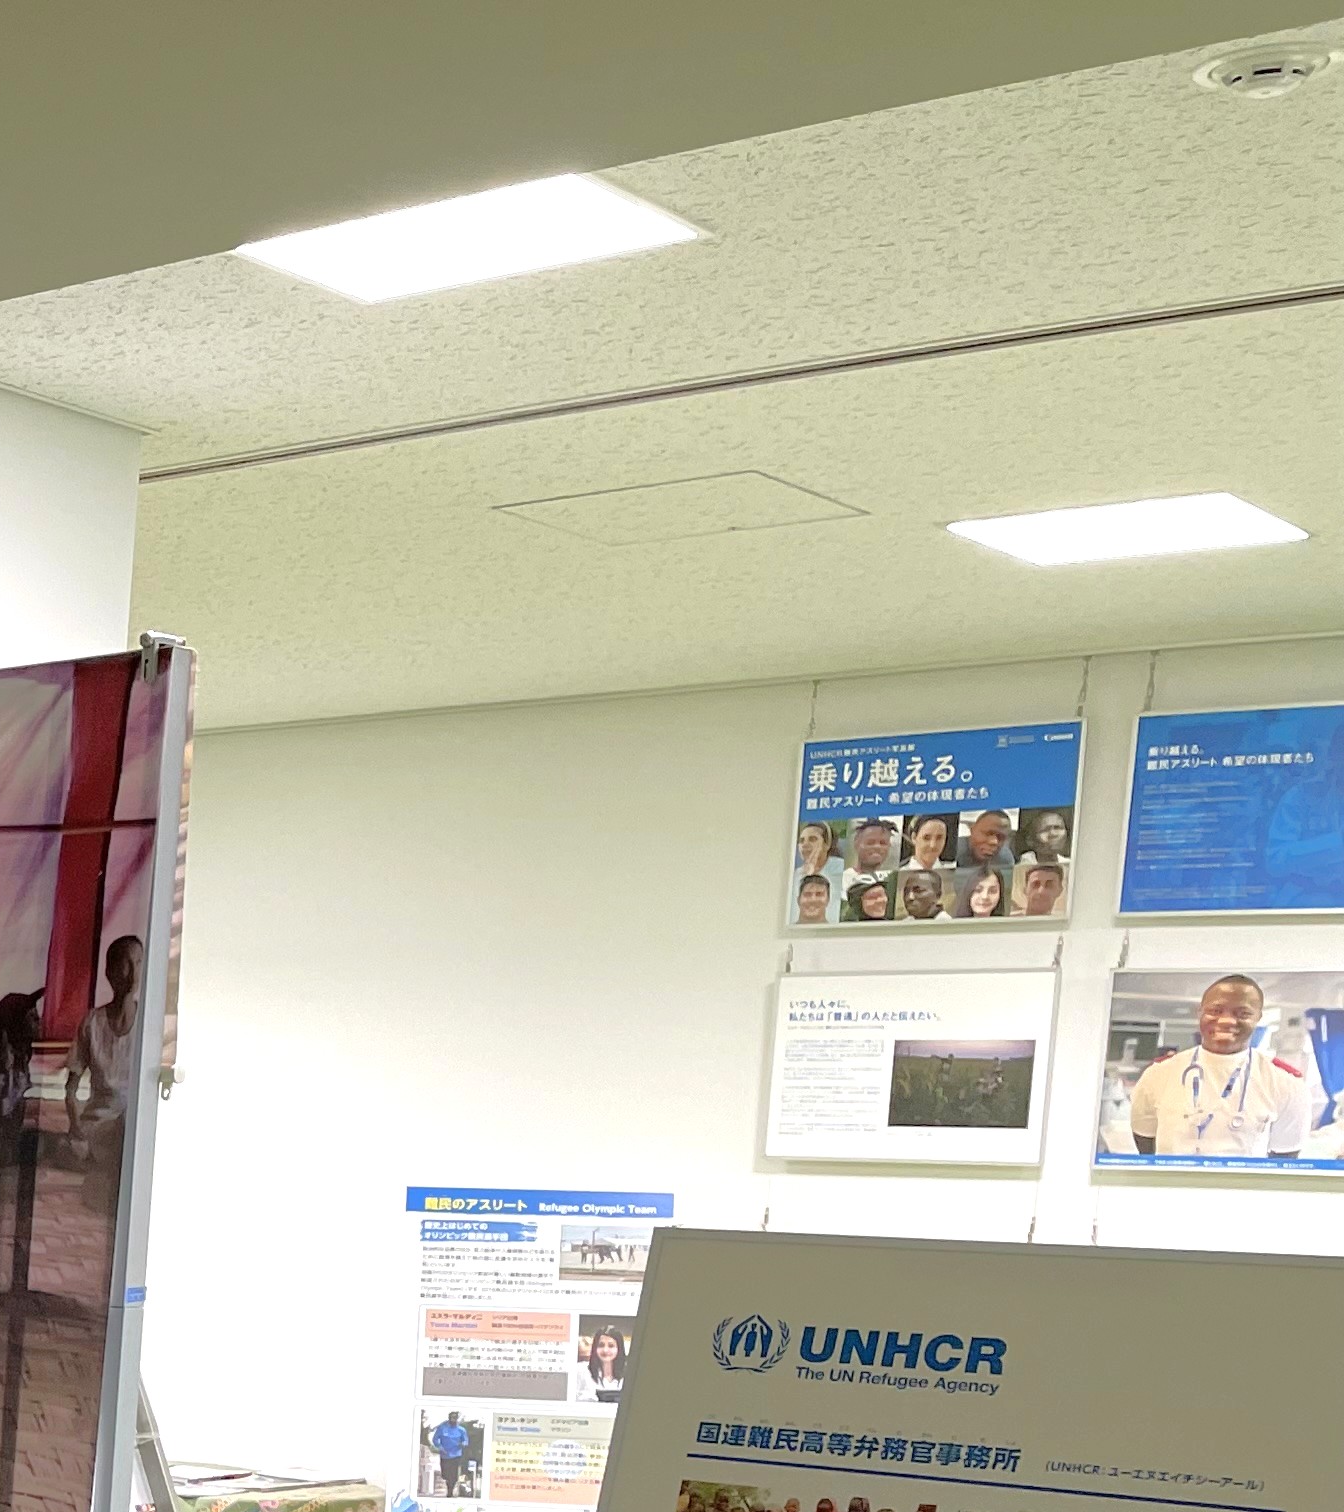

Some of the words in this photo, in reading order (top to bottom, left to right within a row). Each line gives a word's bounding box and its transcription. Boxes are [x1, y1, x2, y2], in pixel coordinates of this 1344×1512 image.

[808, 754, 974, 793] 乗り越える。
[806, 794, 883, 811] 難民アスリート
[888, 787, 989, 805] 希望の体現者たち
[424, 1196, 528, 1212] 難民のアスリート
[539, 1202, 580, 1214] Refugee
[582, 1203, 625, 1215] Olympic
[628, 1204, 658, 1215] Team
[799, 1325, 1008, 1376] UNHCR
[796, 1366, 825, 1381] The
[829, 1369, 855, 1383] UN
[859, 1371, 929, 1390] Refugee
[933, 1377, 1000, 1397] Agency
[696, 1421, 1021, 1473] 国連難民高等弁務官事務所
